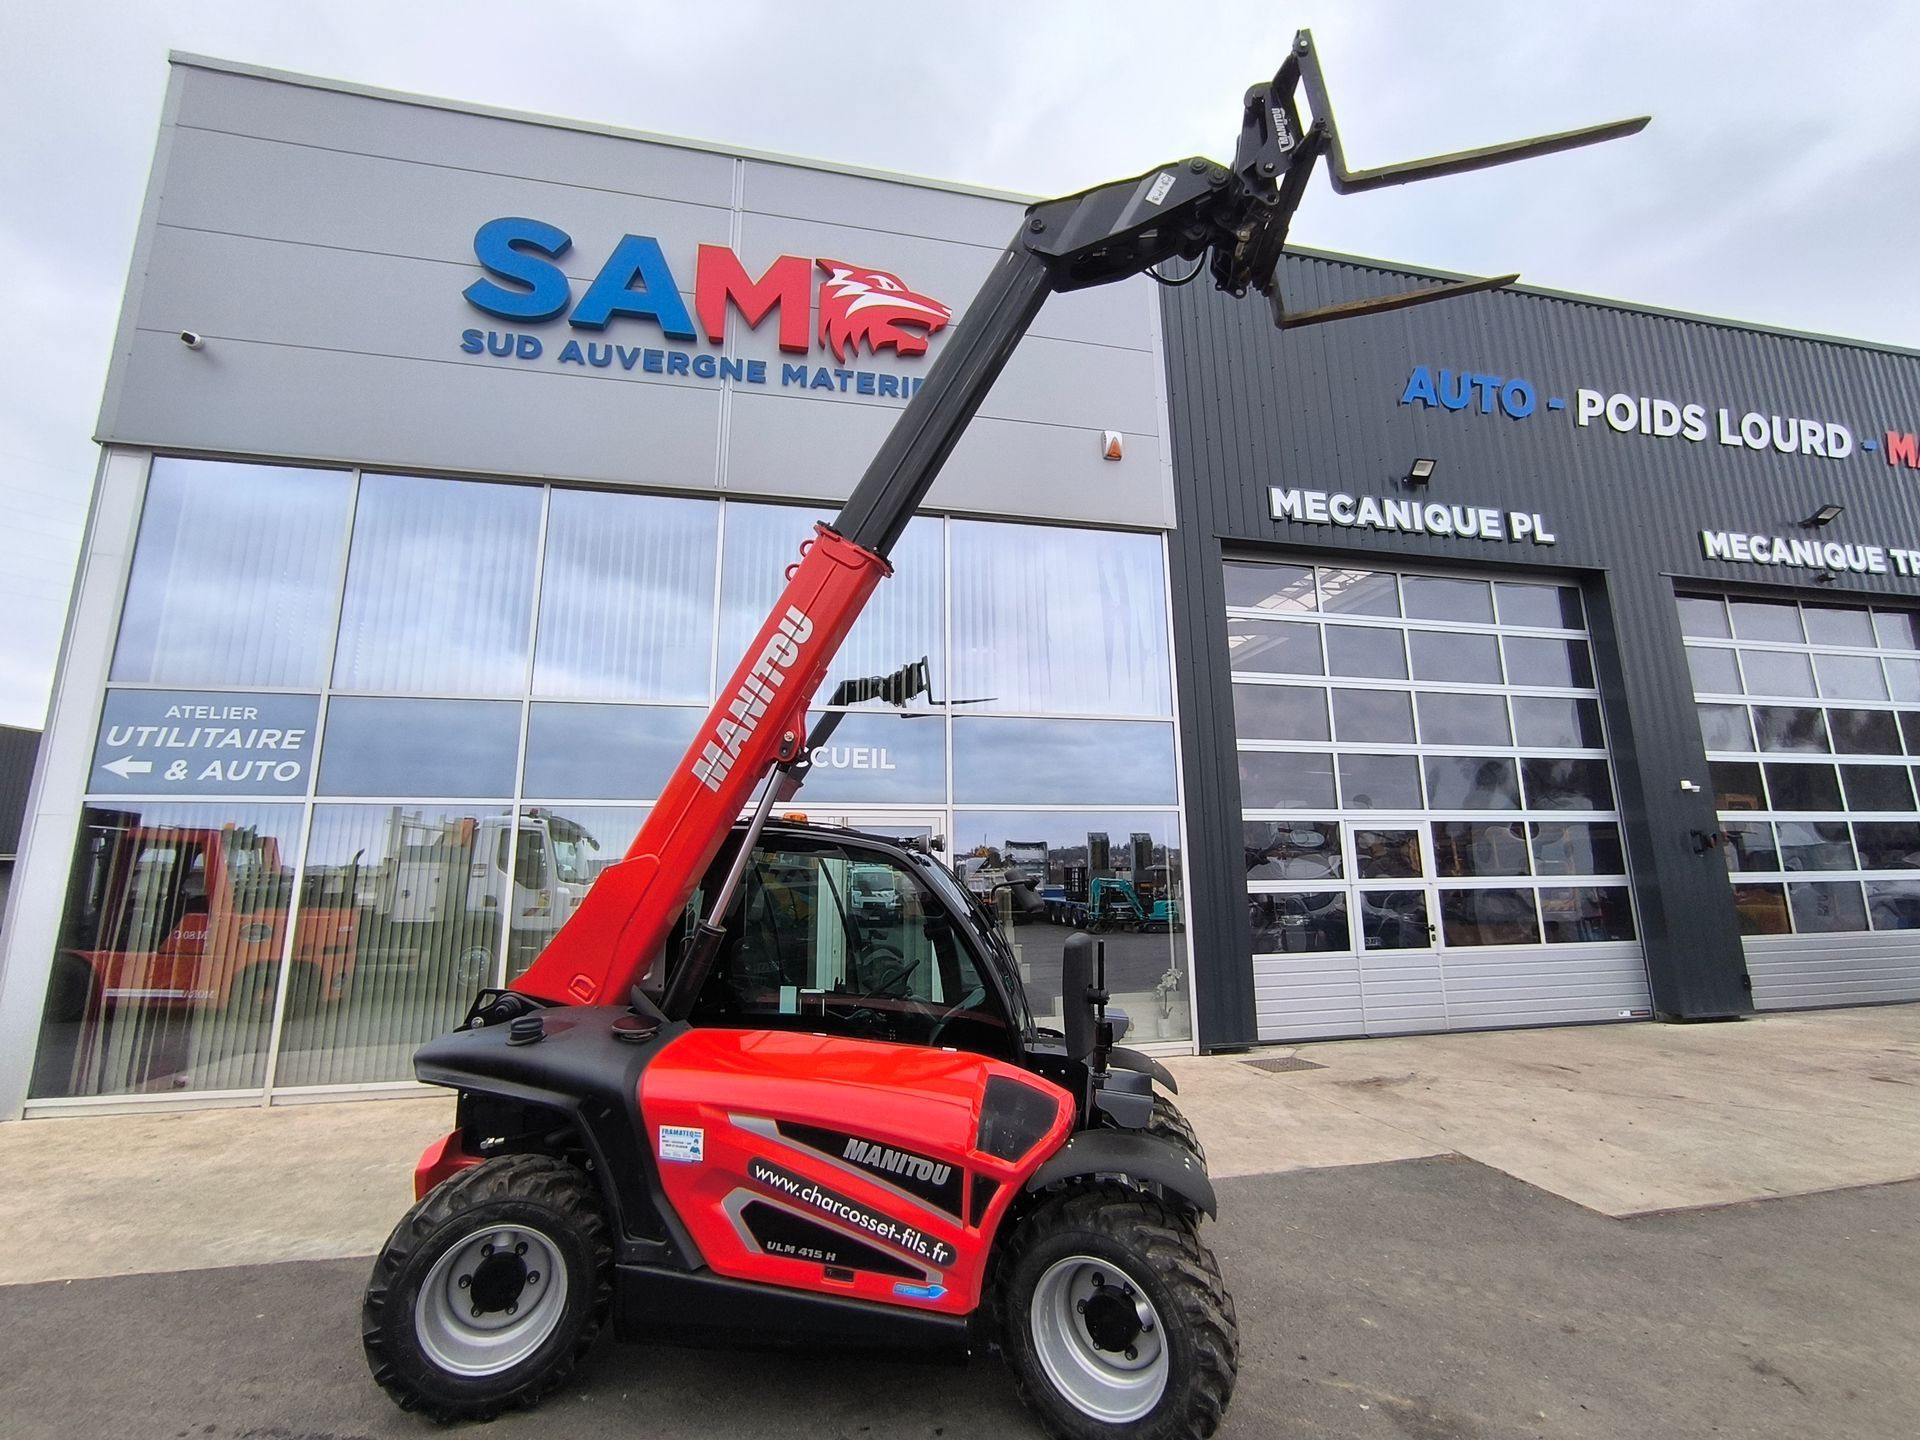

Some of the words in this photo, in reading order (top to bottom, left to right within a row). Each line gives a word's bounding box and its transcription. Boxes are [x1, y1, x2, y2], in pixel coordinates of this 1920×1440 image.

[1272, 107, 1289, 146] MANITOU
[462, 216, 812, 354] SAM
[460, 328, 543, 360] SUD
[557, 340, 766, 384] AUVERGNE
[1401, 364, 1536, 418] AUTO
[1578, 388, 1707, 441] POIDS
[1719, 408, 1852, 459] LOURD
[1886, 430, 1920, 469] M
[1269, 486, 1502, 540] MECANIQUE
[1509, 511, 1556, 545] PL
[1702, 530, 1887, 575] MECANIQUE
[164, 705, 258, 720] ATELIER
[691, 604, 813, 793] MANITOU
[106, 726, 306, 750] UTILITAIRE
[164, 759, 188, 781] &
[197, 760, 301, 782] AUTO
[843, 1138, 951, 1186] MANITOU
[755, 1165, 949, 1263] www.charcosset-fils.fr
[766, 1241, 796, 1254] ULM
[798, 1247, 823, 1259] 415
[825, 1252, 836, 1261] H
